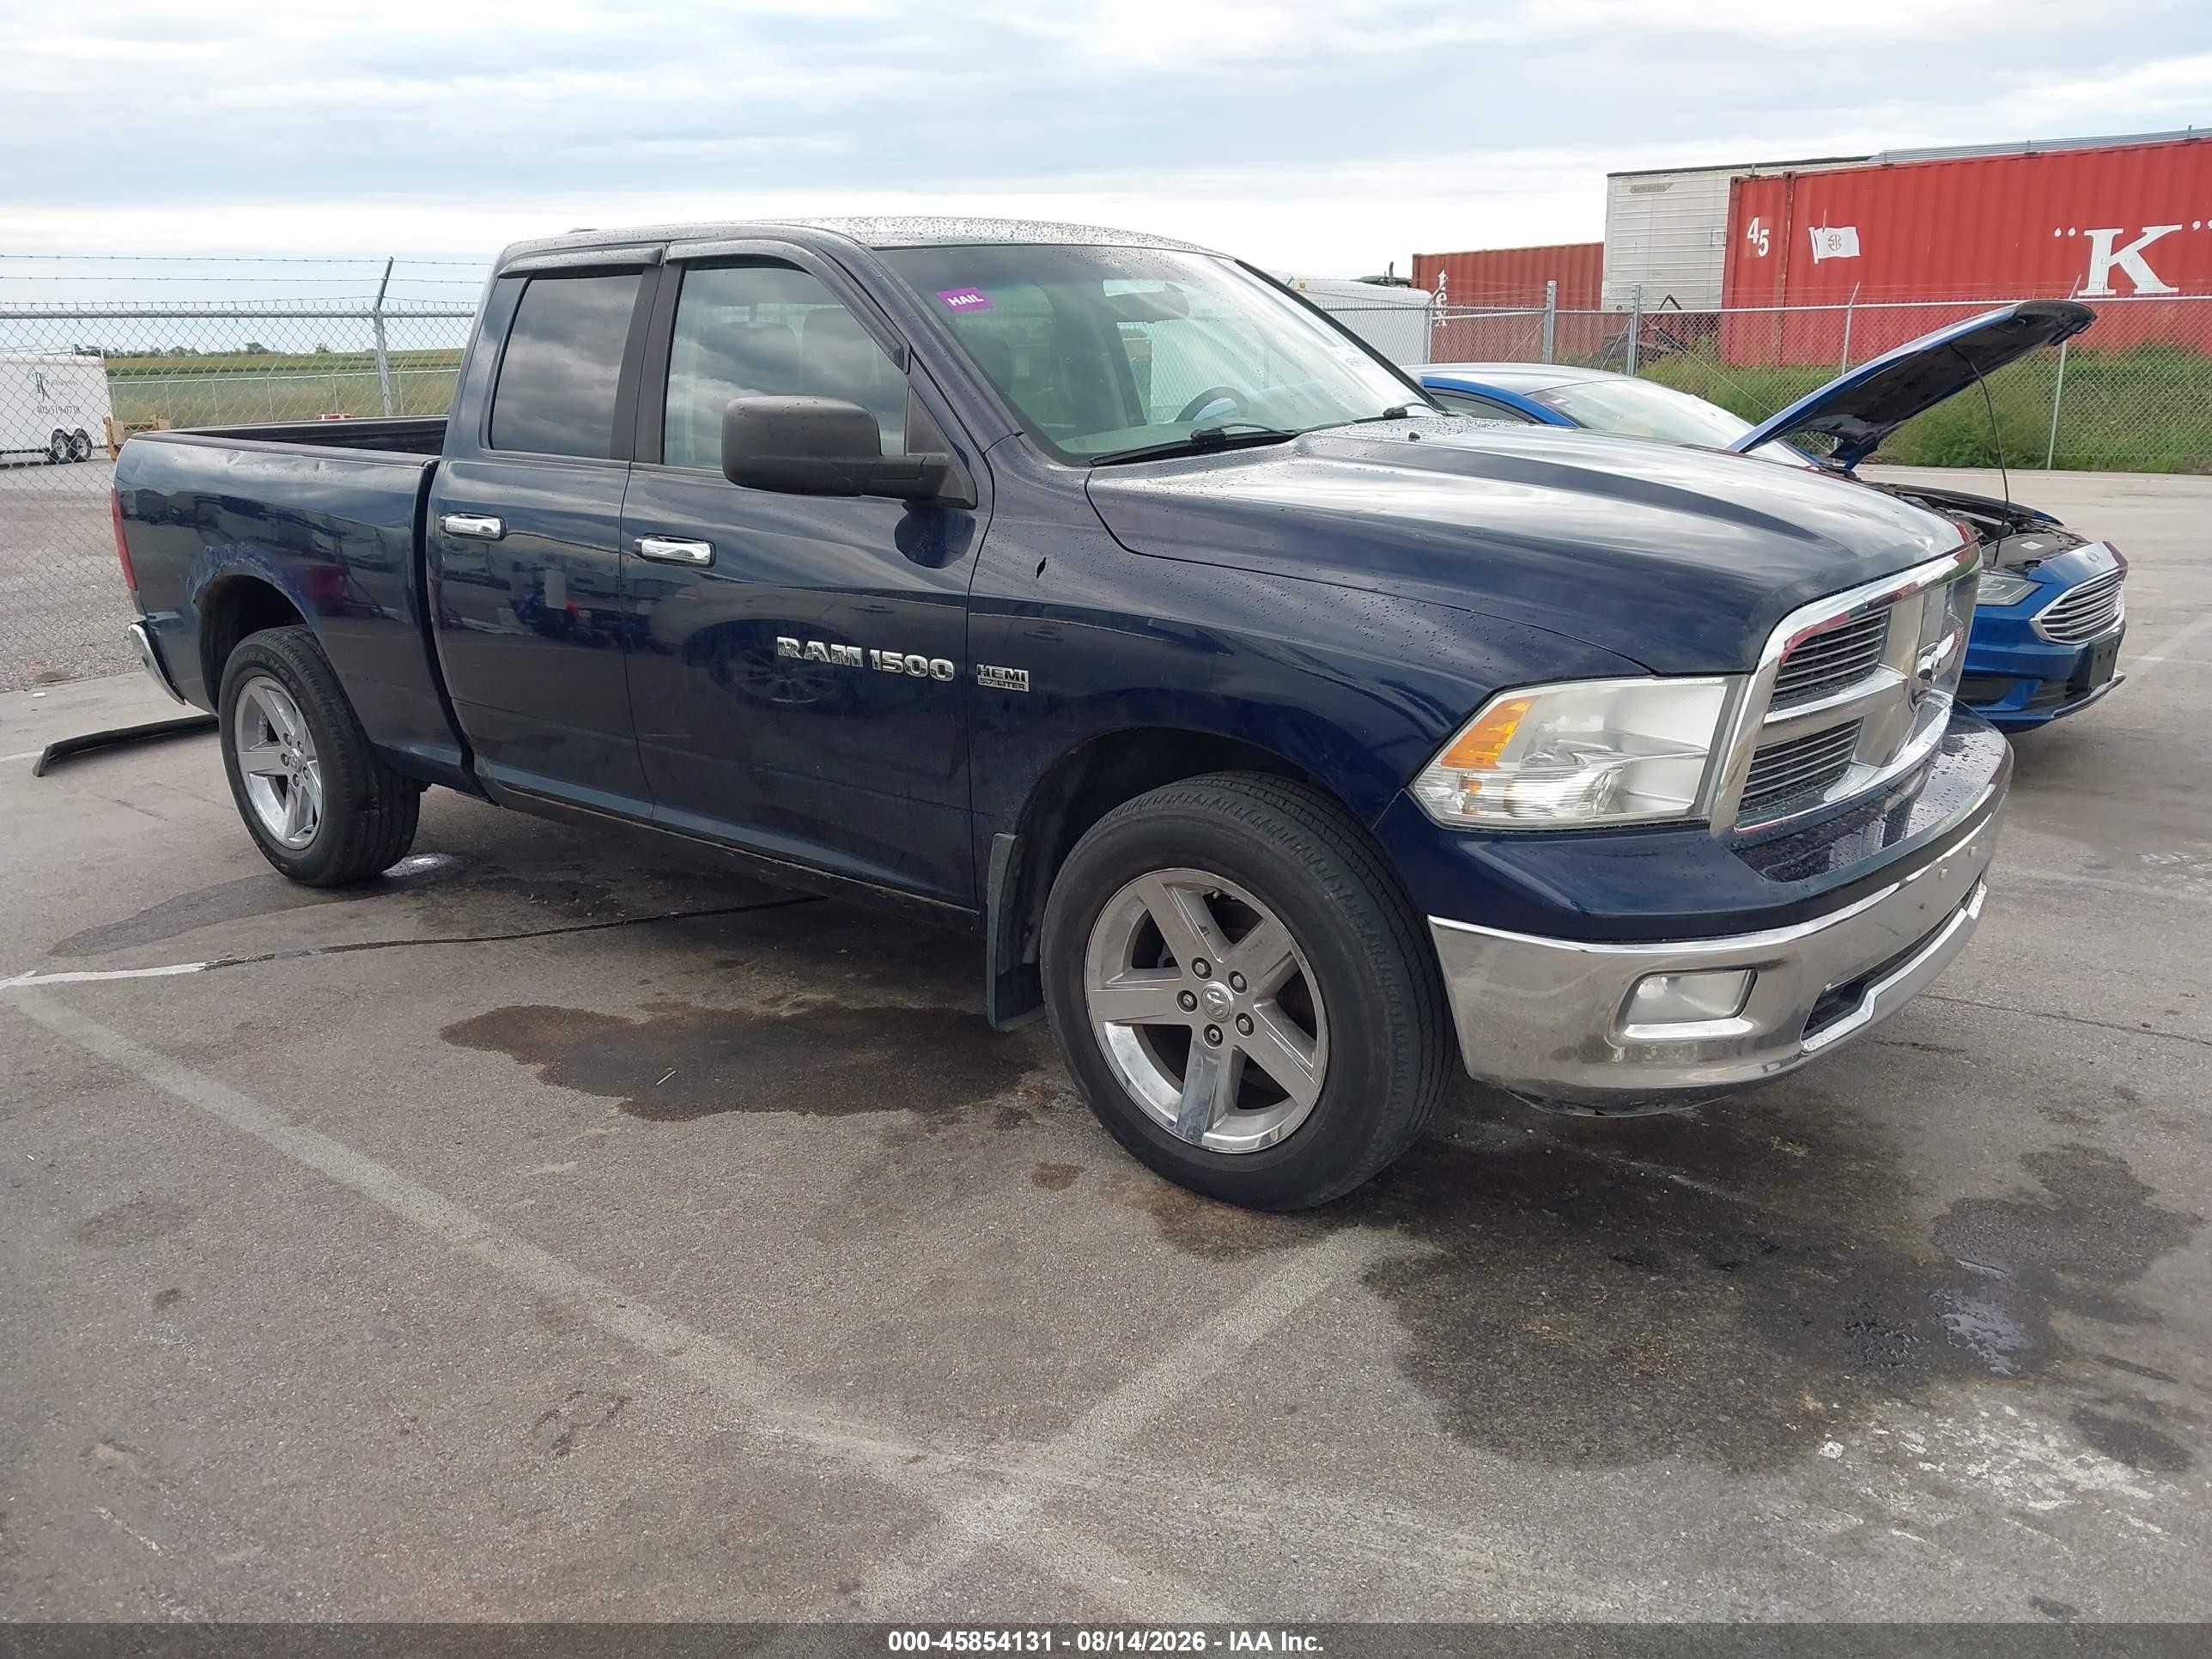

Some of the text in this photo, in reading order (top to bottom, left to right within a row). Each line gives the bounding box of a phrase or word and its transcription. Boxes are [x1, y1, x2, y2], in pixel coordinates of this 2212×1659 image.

[1747, 216, 1770, 257] 45
[946, 293, 985, 307] HAIL
[776, 635, 955, 683] RAM 1500
[976, 664, 1028, 684] HEMI
[997, 679, 1026, 690] LITER
